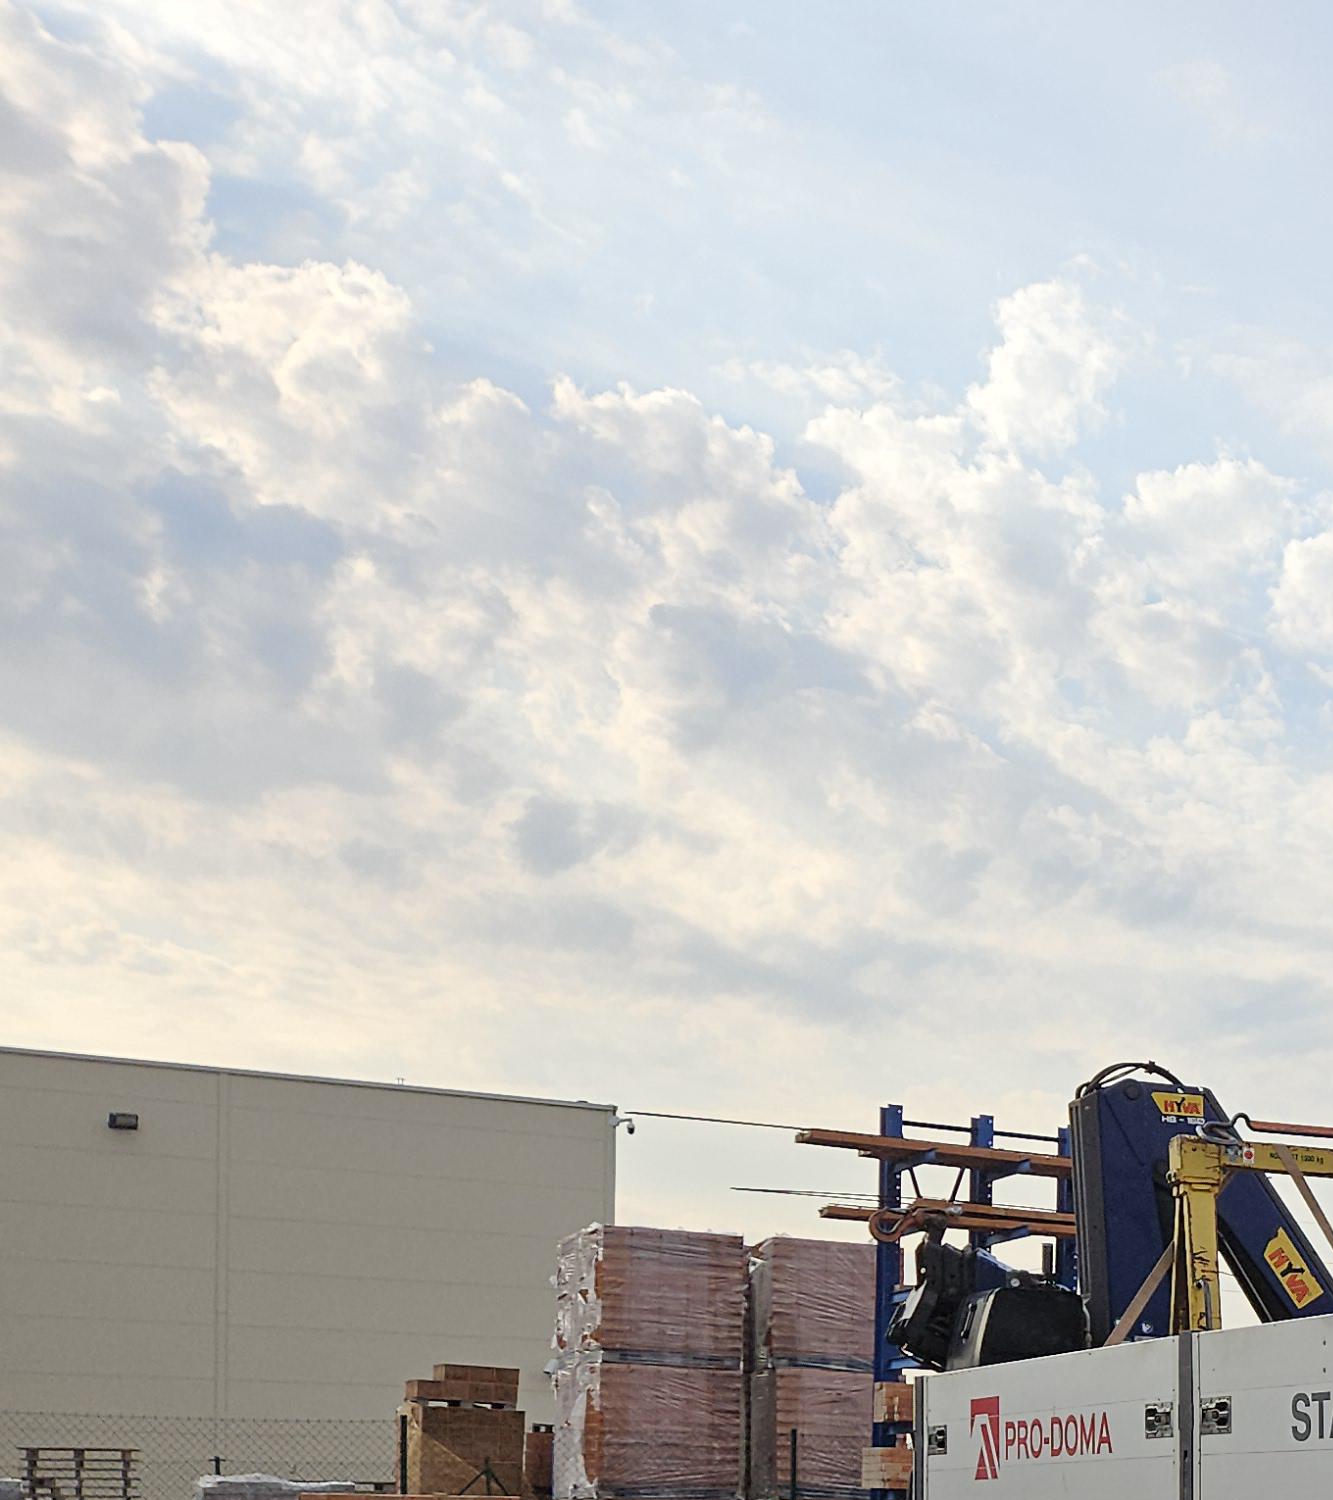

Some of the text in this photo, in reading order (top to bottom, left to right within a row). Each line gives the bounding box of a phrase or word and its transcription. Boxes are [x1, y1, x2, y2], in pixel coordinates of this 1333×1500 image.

[1164, 1096, 1201, 1115] HYVA
[1268, 1247, 1310, 1303] HYVA
[1005, 1411, 1113, 1459] PRO-DOMA
